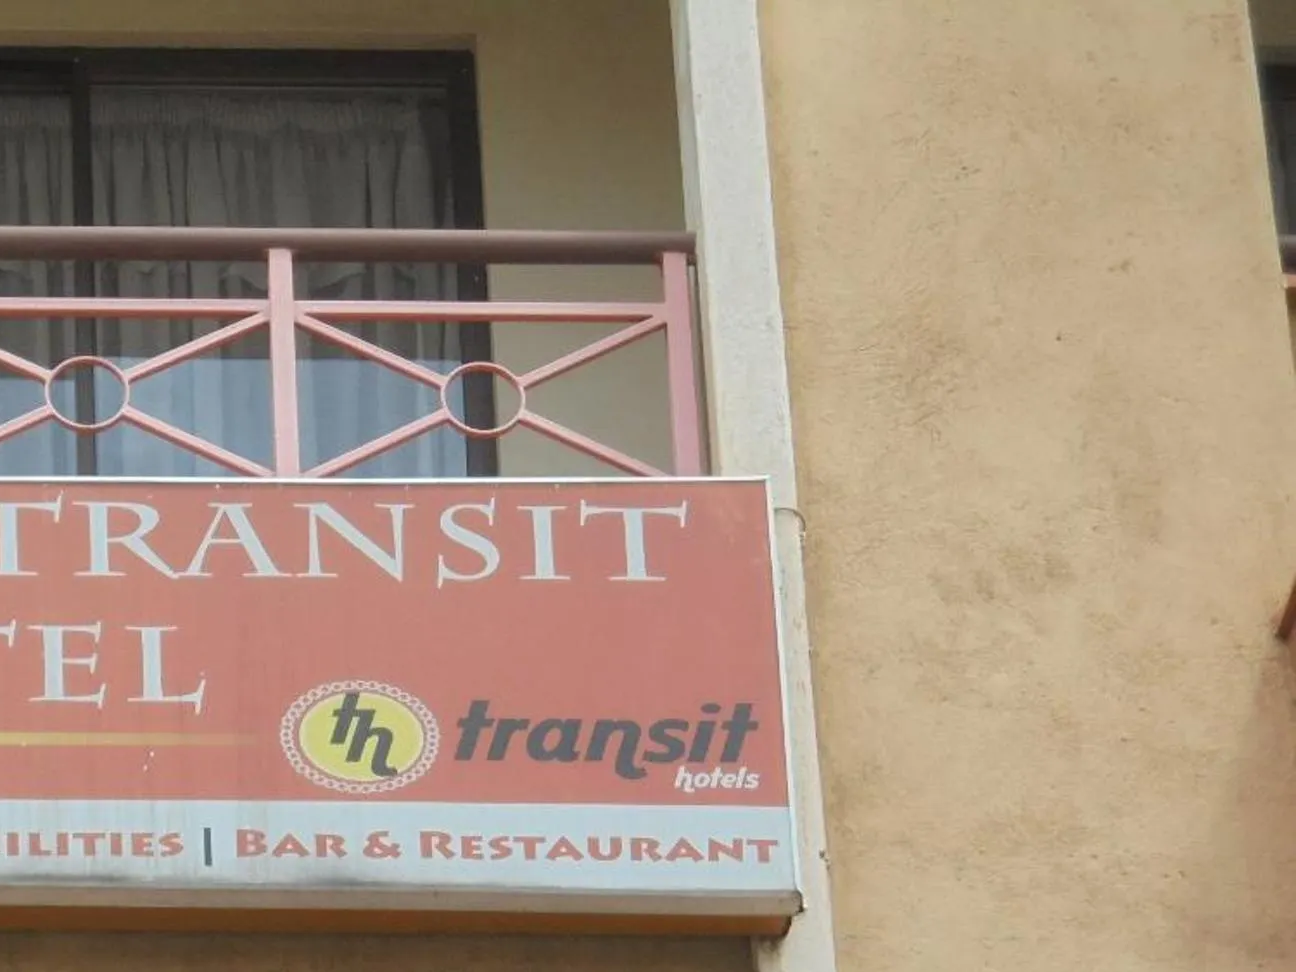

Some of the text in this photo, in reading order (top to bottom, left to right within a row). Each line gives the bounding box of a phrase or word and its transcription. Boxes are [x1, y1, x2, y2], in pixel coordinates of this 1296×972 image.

[454, 699, 760, 780] transit
[673, 765, 761, 794] hotels
[236, 827, 348, 860] BAR
[362, 829, 402, 861] &
[418, 829, 780, 865] RESTAURANT
